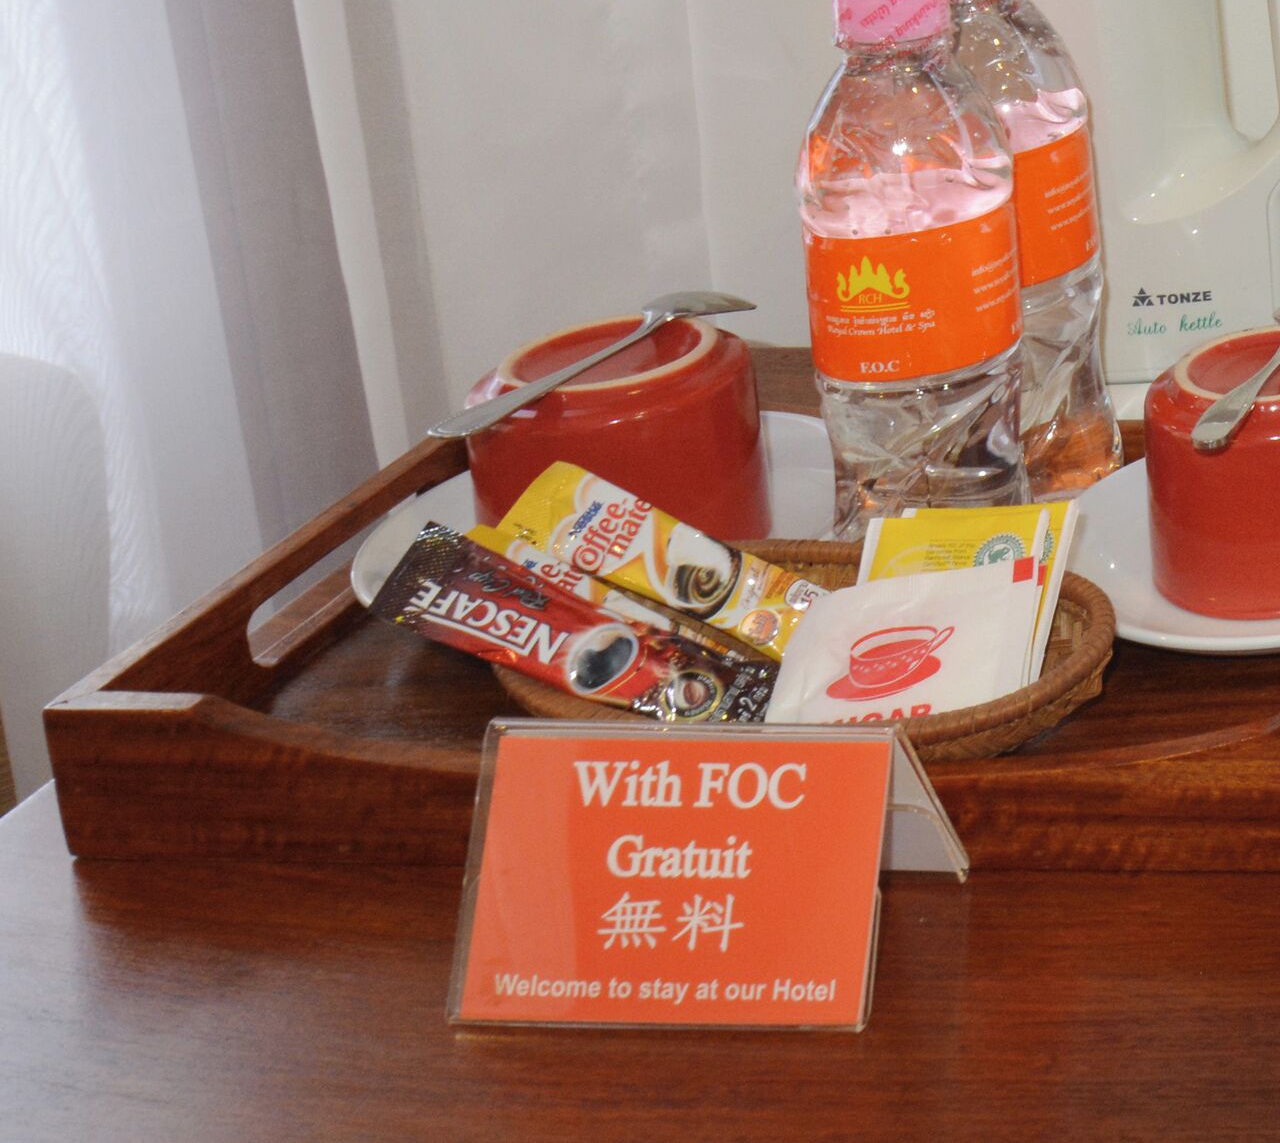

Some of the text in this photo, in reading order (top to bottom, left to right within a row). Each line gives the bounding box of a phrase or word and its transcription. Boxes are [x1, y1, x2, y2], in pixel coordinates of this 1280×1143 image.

[1156, 290, 1213, 305] TONZE
[1127, 311, 1223, 337] Auto kettle
[860, 359, 900, 374] F.O.C
[606, 498, 652, 559] mate
[574, 759, 808, 809] With FOC
[607, 834, 753, 880] Gratuit
[597, 891, 745, 952] 無料
[494, 973, 836, 1006] Welcome to stay at our Hotel
